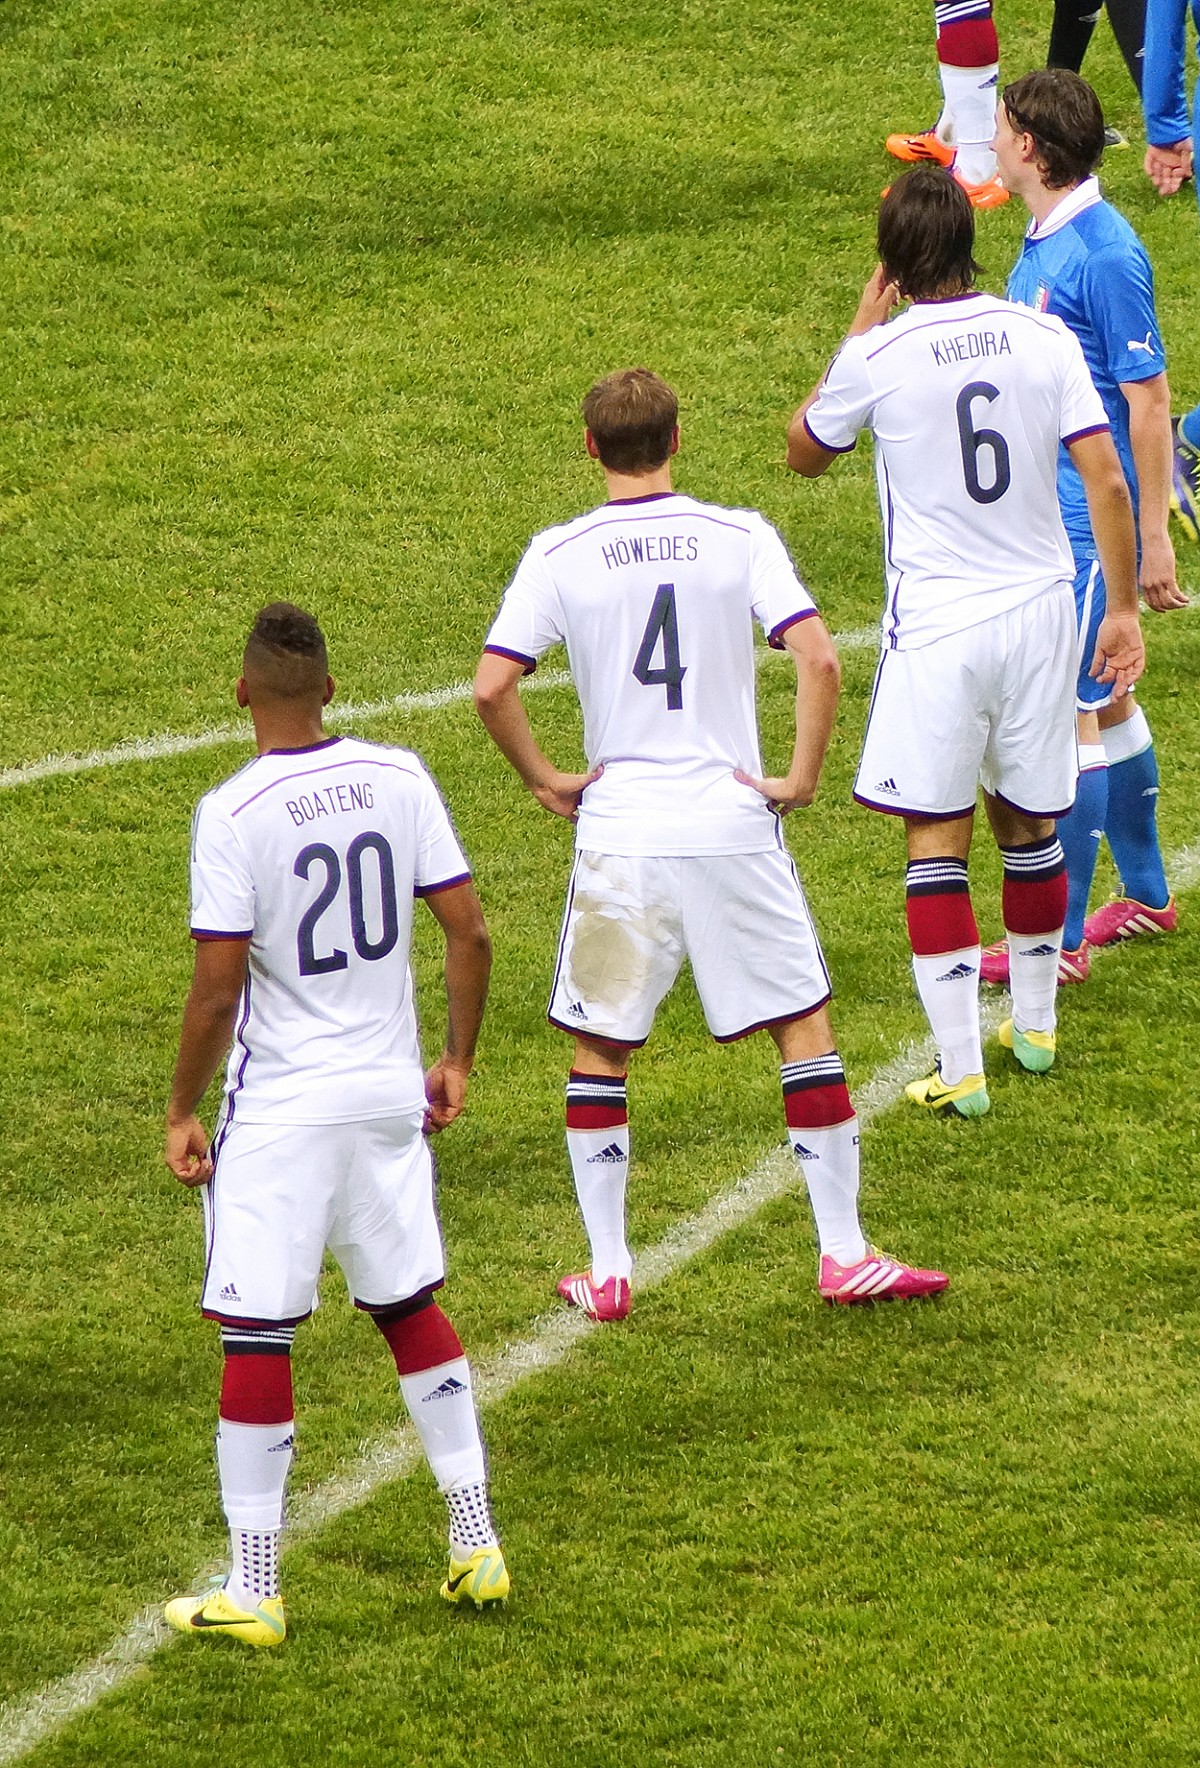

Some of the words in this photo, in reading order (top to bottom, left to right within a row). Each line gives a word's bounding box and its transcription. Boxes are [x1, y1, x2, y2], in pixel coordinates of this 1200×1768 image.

[930, 330, 1012, 366] KHEDIRA
[956, 381, 1011, 504] 6
[602, 536, 699, 570] HÖWEDES
[632, 583, 688, 710] 4
[286, 783, 375, 827] BOATENG
[293, 830, 399, 976] 20
